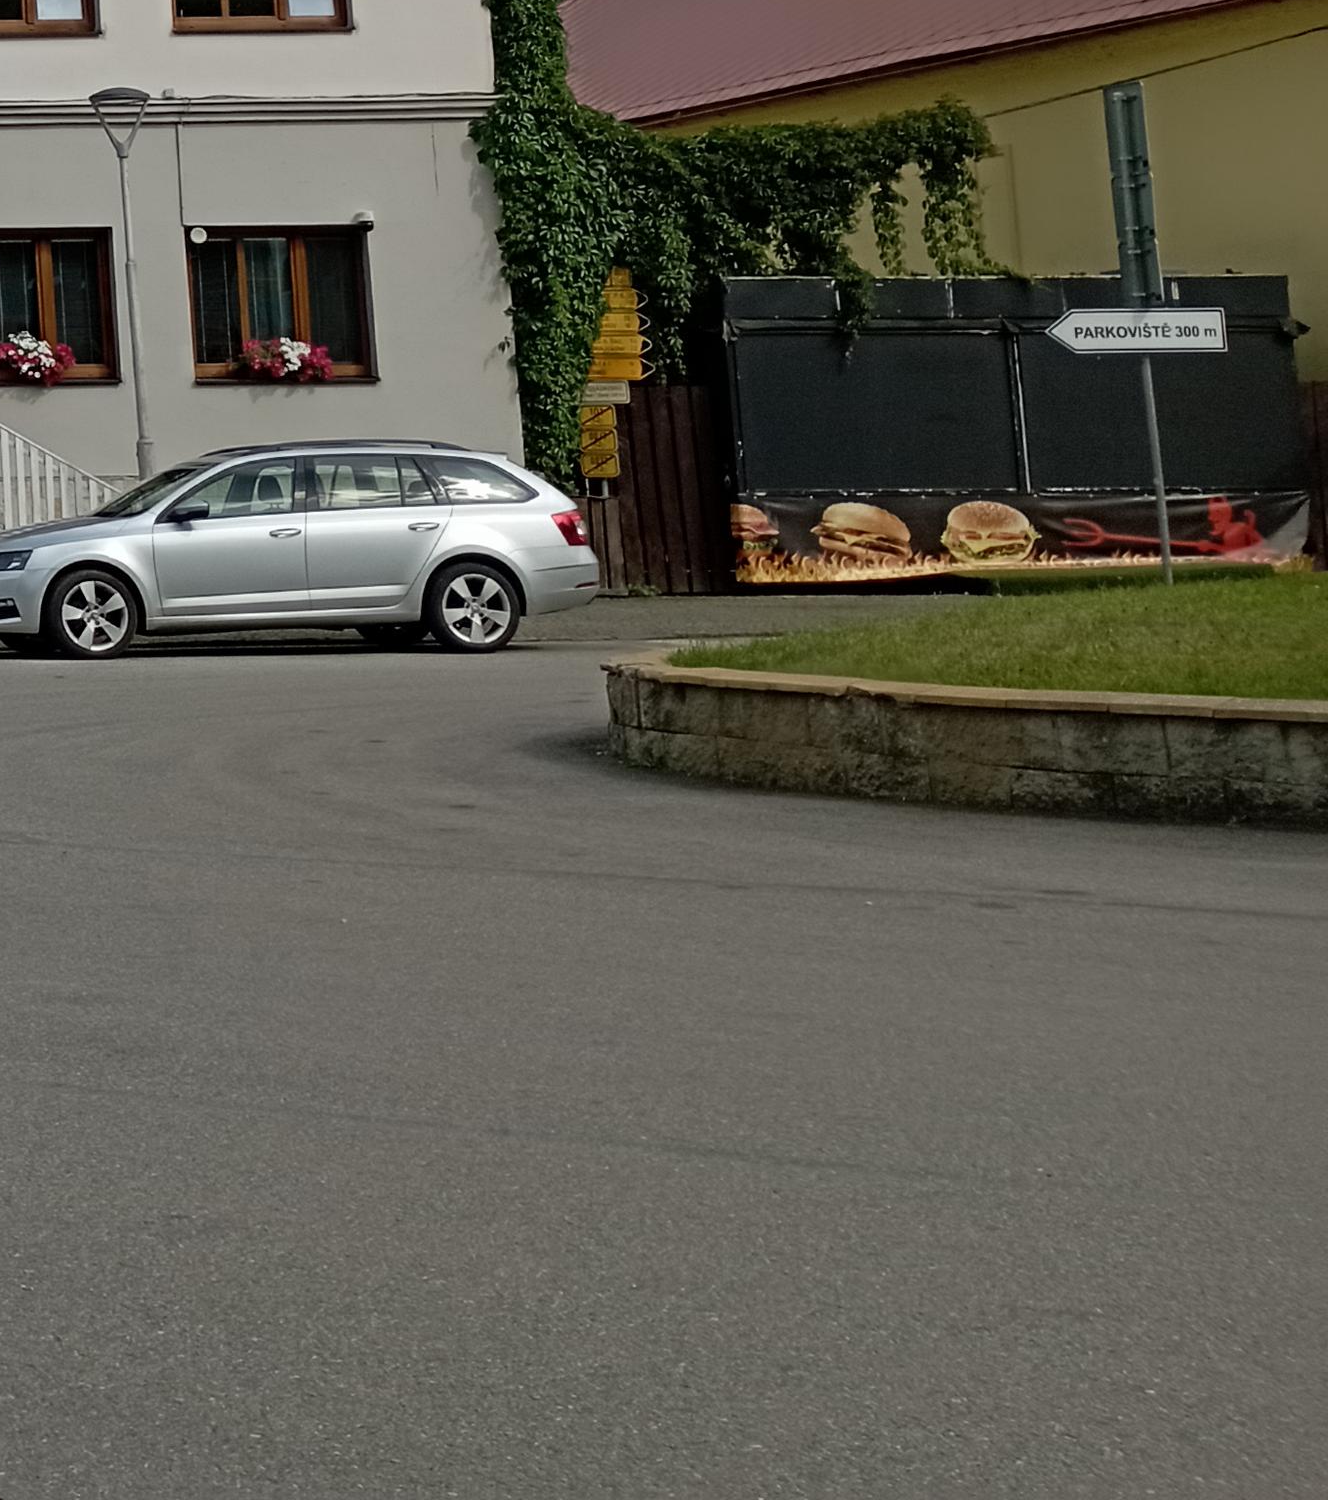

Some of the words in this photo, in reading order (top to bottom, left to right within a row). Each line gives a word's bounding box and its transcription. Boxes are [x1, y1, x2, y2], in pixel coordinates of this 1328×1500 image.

[1074, 323, 1171, 339] PARKOVIŠTĚ
[1175, 326, 1200, 338] 300
[1205, 328, 1217, 337] m
